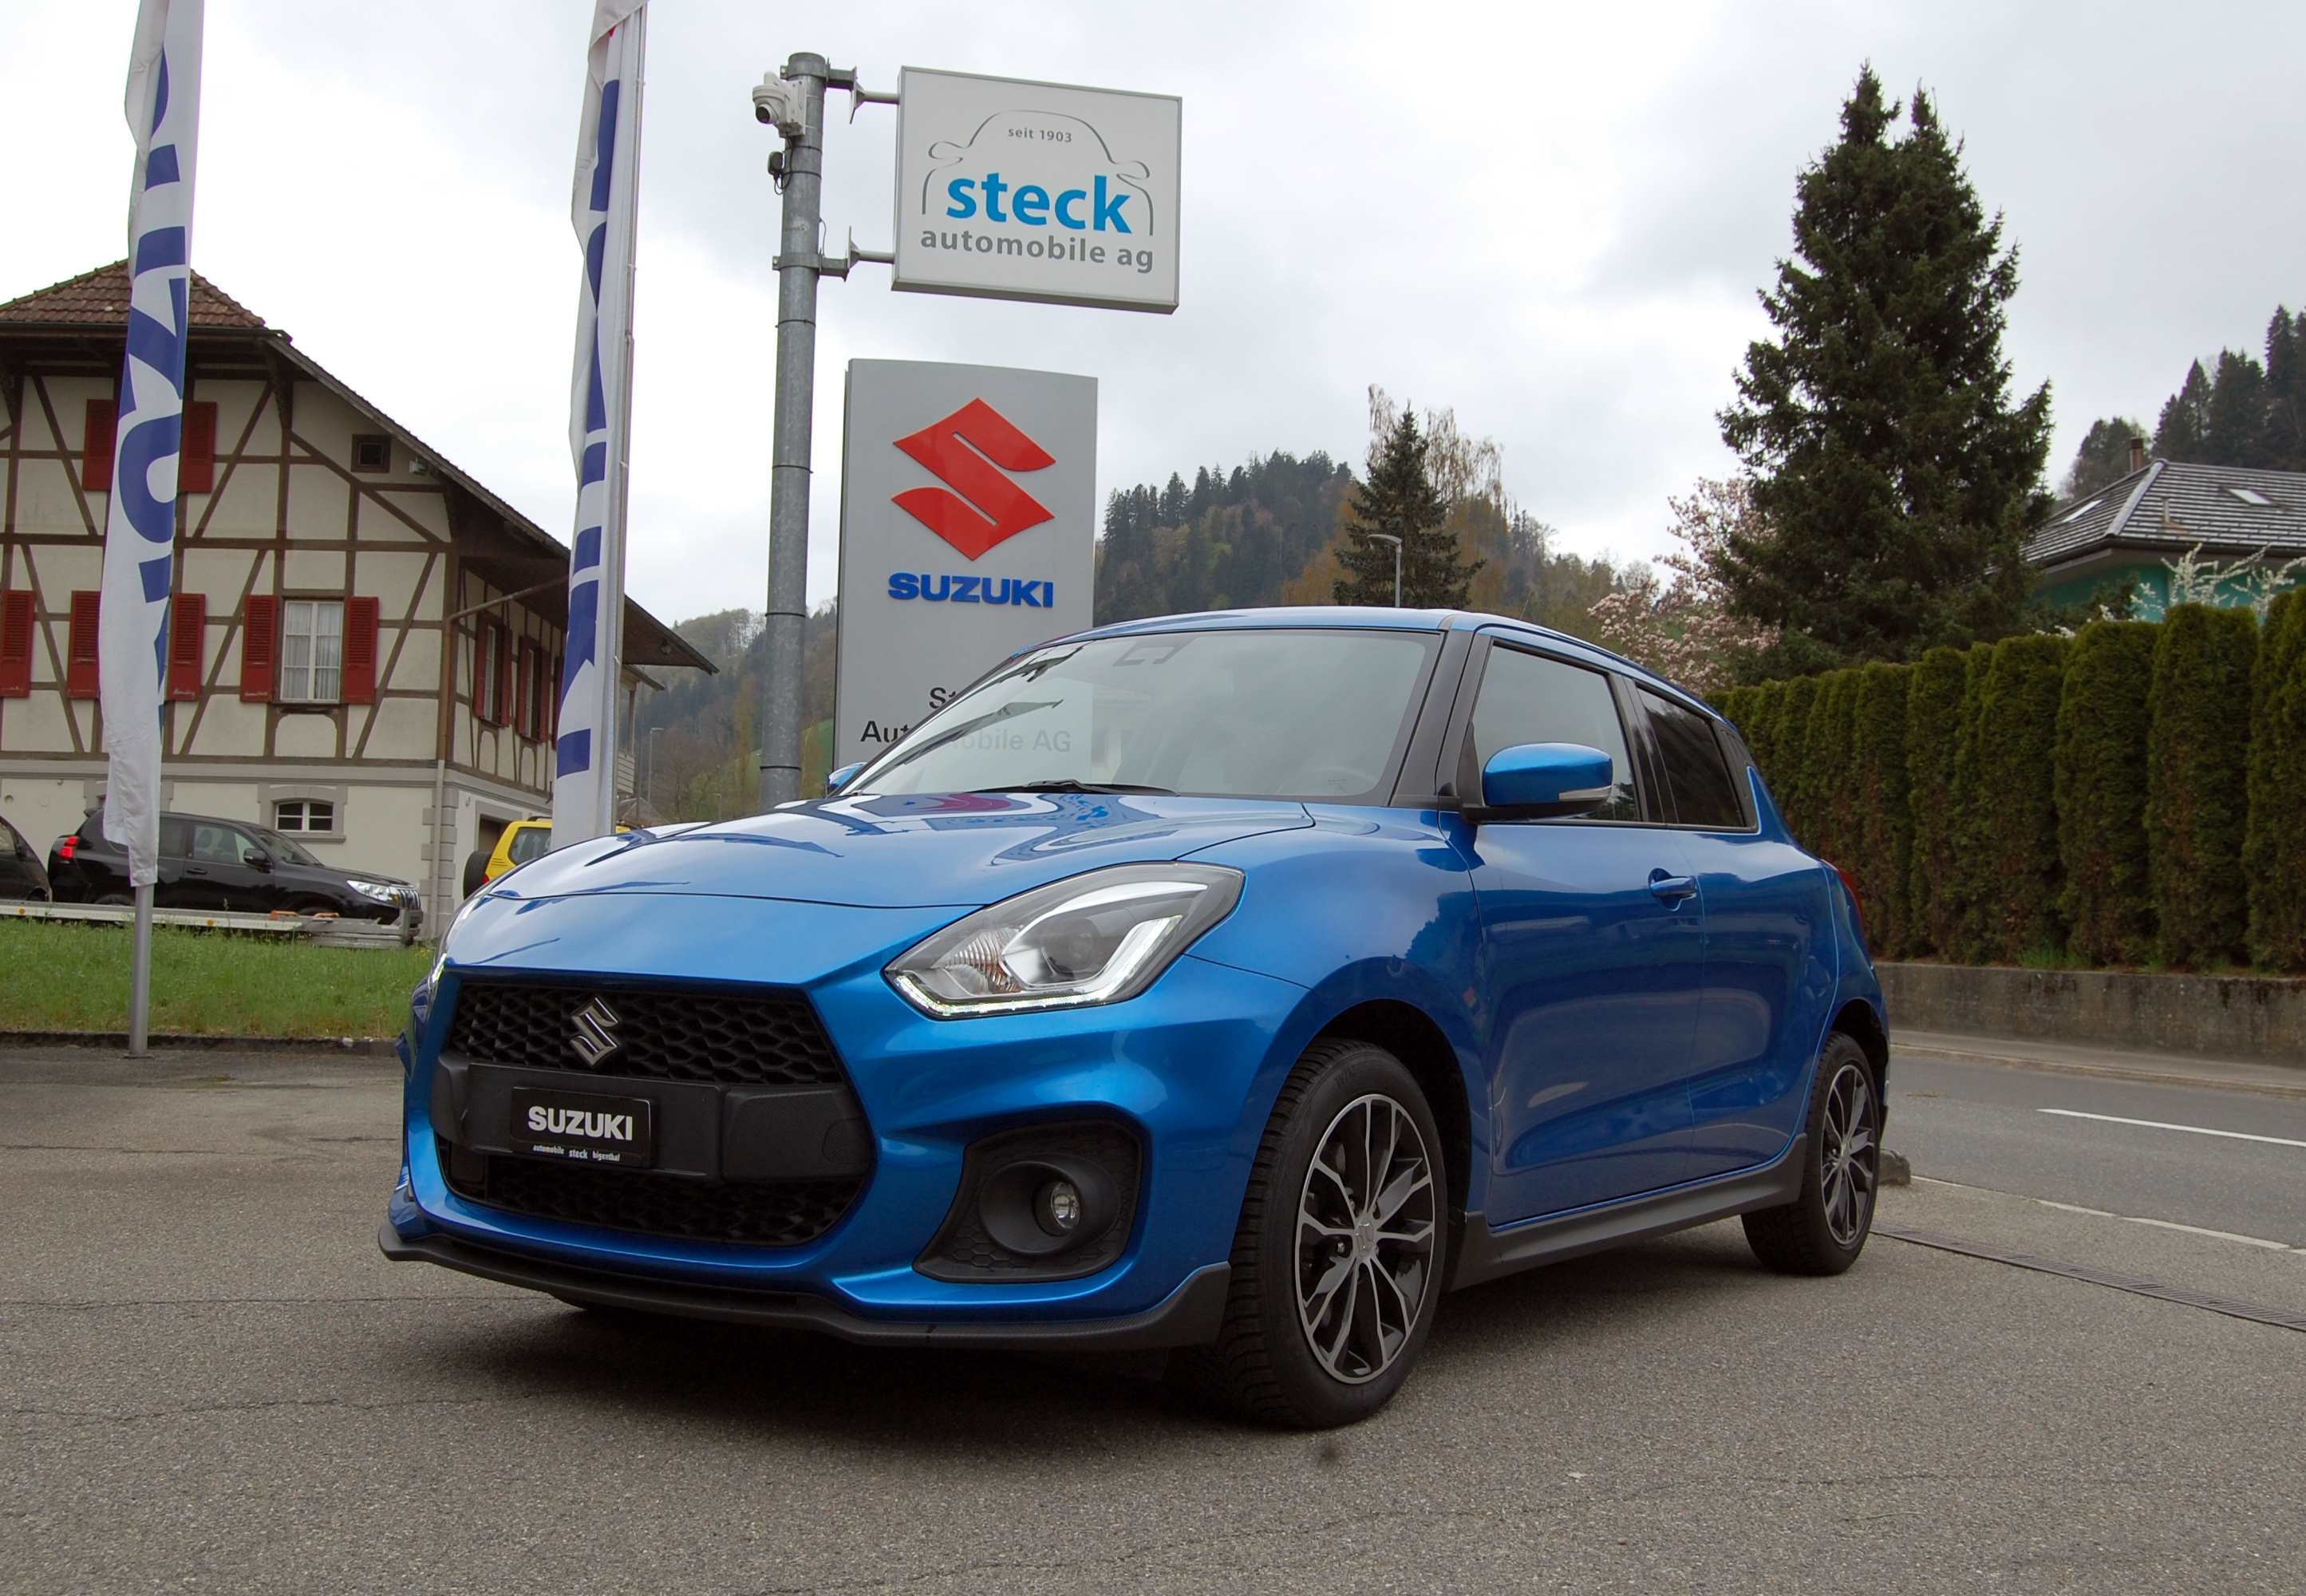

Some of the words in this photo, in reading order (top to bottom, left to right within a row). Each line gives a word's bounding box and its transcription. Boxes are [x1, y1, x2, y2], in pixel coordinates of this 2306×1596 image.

[1008, 126, 1033, 140] seit
[1040, 129, 1072, 143] 1903
[946, 172, 1131, 235] steck
[921, 228, 1105, 264] automobile
[1117, 246, 1154, 275] ag
[888, 572, 1054, 608] SUZUKI
[1033, 729, 1072, 753] AG
[528, 1105, 633, 1140] SUZUKI
